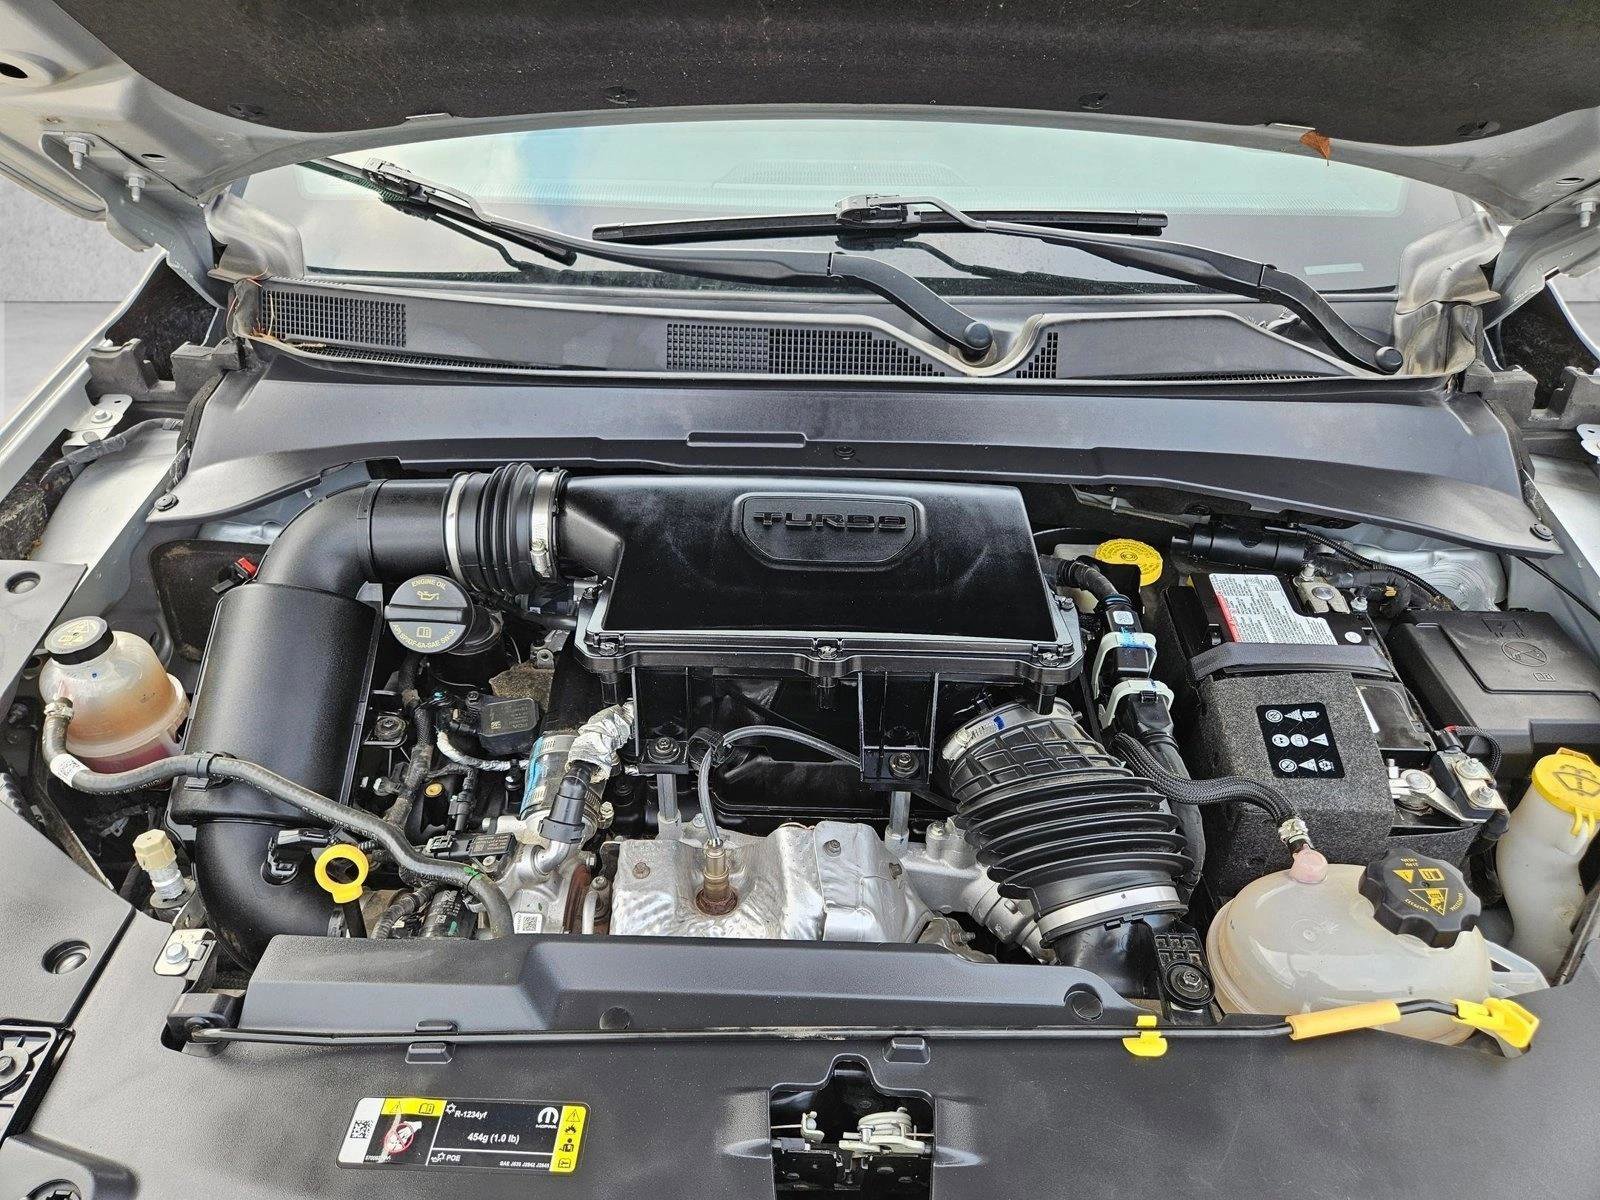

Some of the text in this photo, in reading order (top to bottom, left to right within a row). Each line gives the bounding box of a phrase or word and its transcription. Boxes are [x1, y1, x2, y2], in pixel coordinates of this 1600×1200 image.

[752, 511, 908, 531] TURBO
[411, 578, 447, 591] ENGINE OIL
[454, 1110, 488, 1120] R-1234yf
[467, 1132, 520, 1145] 454g (1.0 lb)
[445, 1154, 461, 1162] POE
